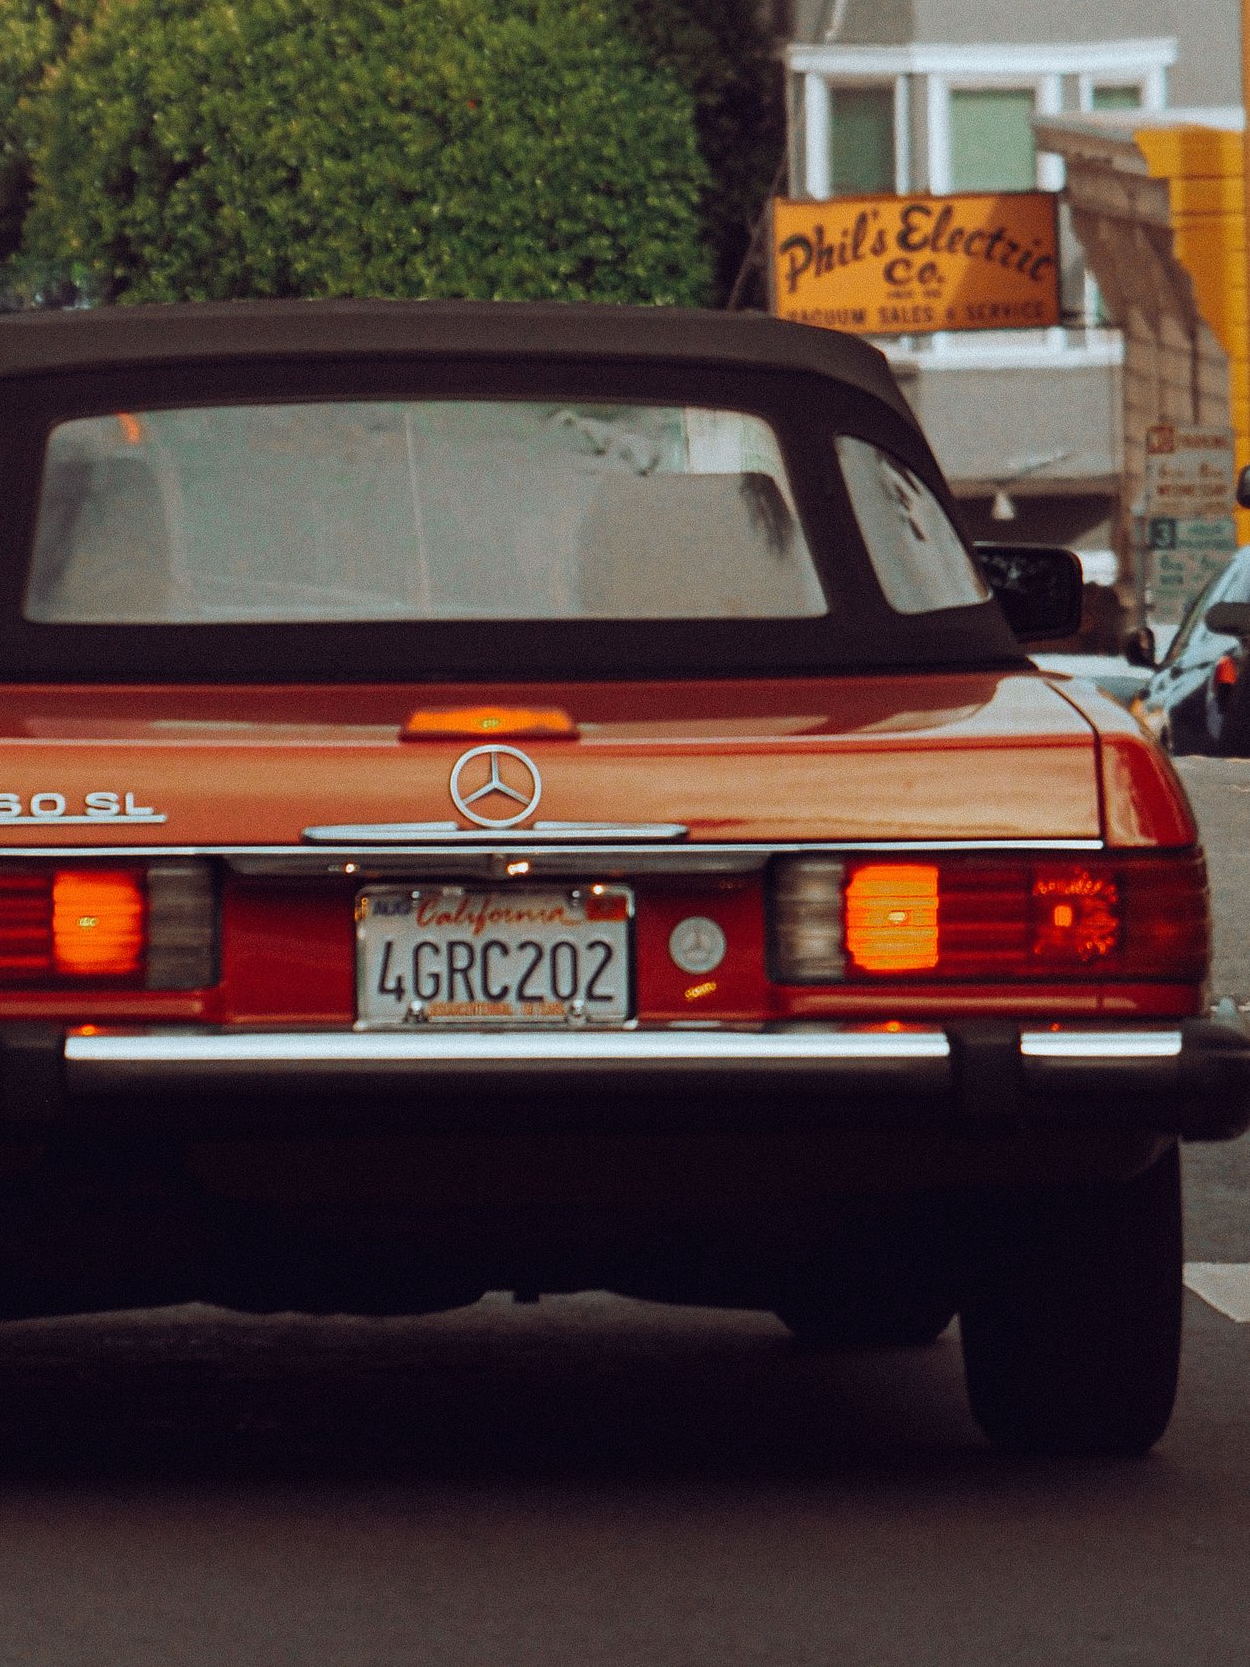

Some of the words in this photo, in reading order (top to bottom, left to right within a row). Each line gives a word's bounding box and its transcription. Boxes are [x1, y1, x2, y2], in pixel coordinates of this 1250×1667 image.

[779, 207, 887, 295] Phil's
[895, 204, 1055, 283] Electric
[878, 304, 934, 325] SALES
[964, 301, 1045, 321] SERVICE
[84, 791, 154, 817] SL
[416, 895, 582, 936] California
[377, 940, 615, 1003] 4GRC202
